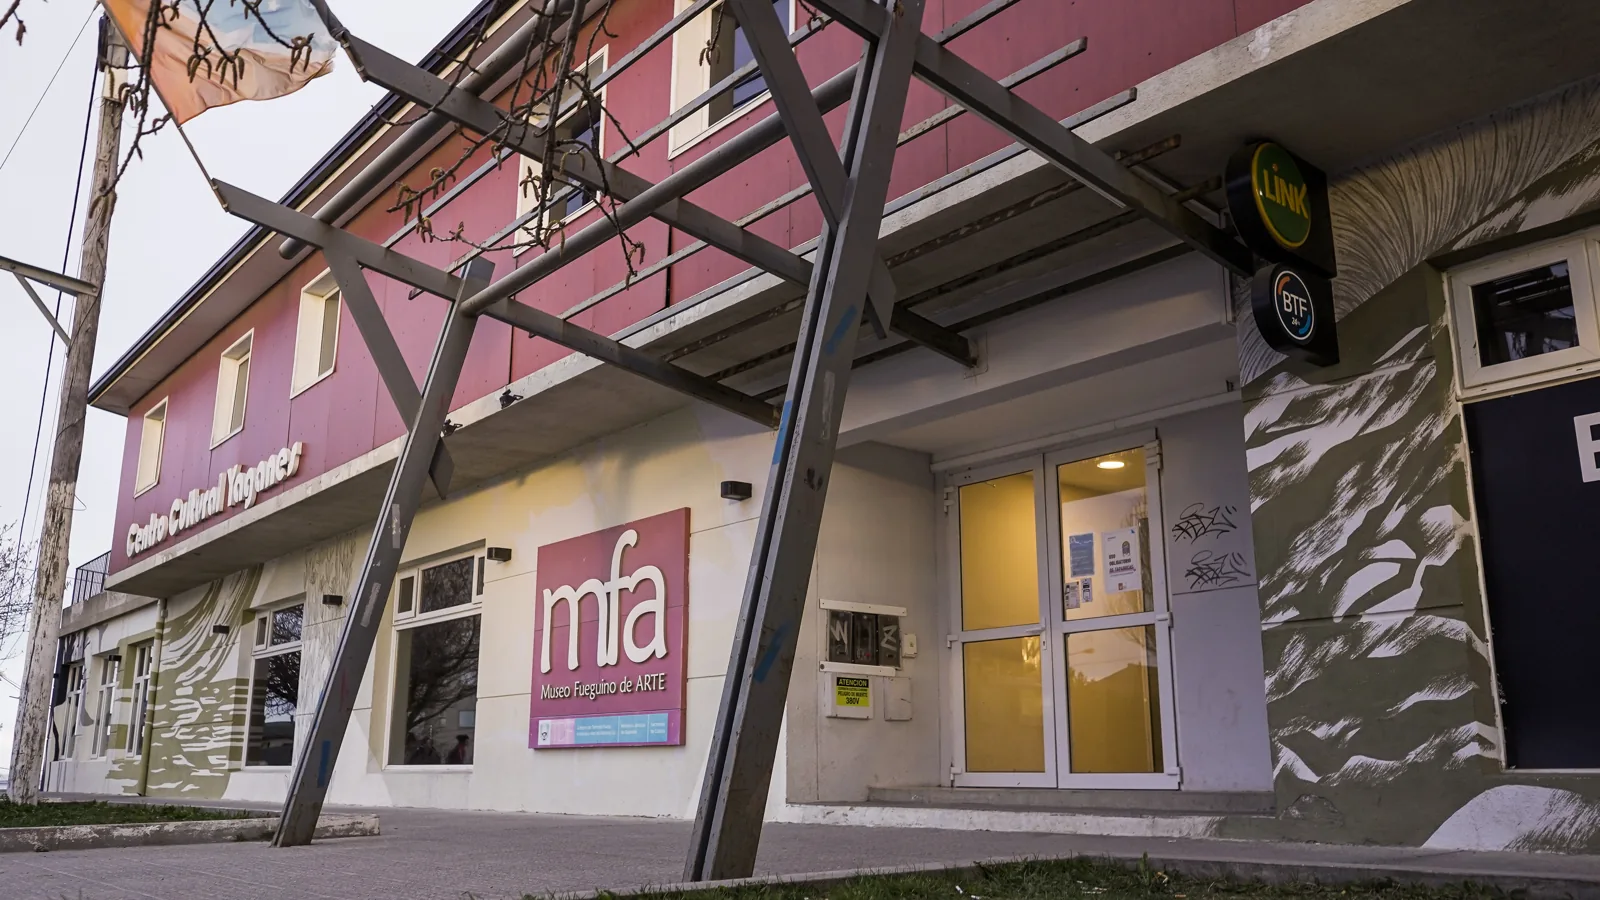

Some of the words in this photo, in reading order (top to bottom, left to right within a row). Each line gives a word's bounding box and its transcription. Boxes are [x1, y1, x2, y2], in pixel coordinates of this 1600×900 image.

[1282, 290, 1308, 318] BTF
[127, 512, 169, 558] Centro
[168, 471, 228, 537] Cultural
[226, 441, 303, 510] Yaganes
[540, 529, 668, 674] mfa
[540, 684, 571, 700] Museo
[573, 678, 616, 700] Fueguino
[619, 676, 632, 693] de
[635, 672, 666, 692] ARTE
[838, 678, 867, 687] ATENCION
[845, 696, 860, 705] 380V
